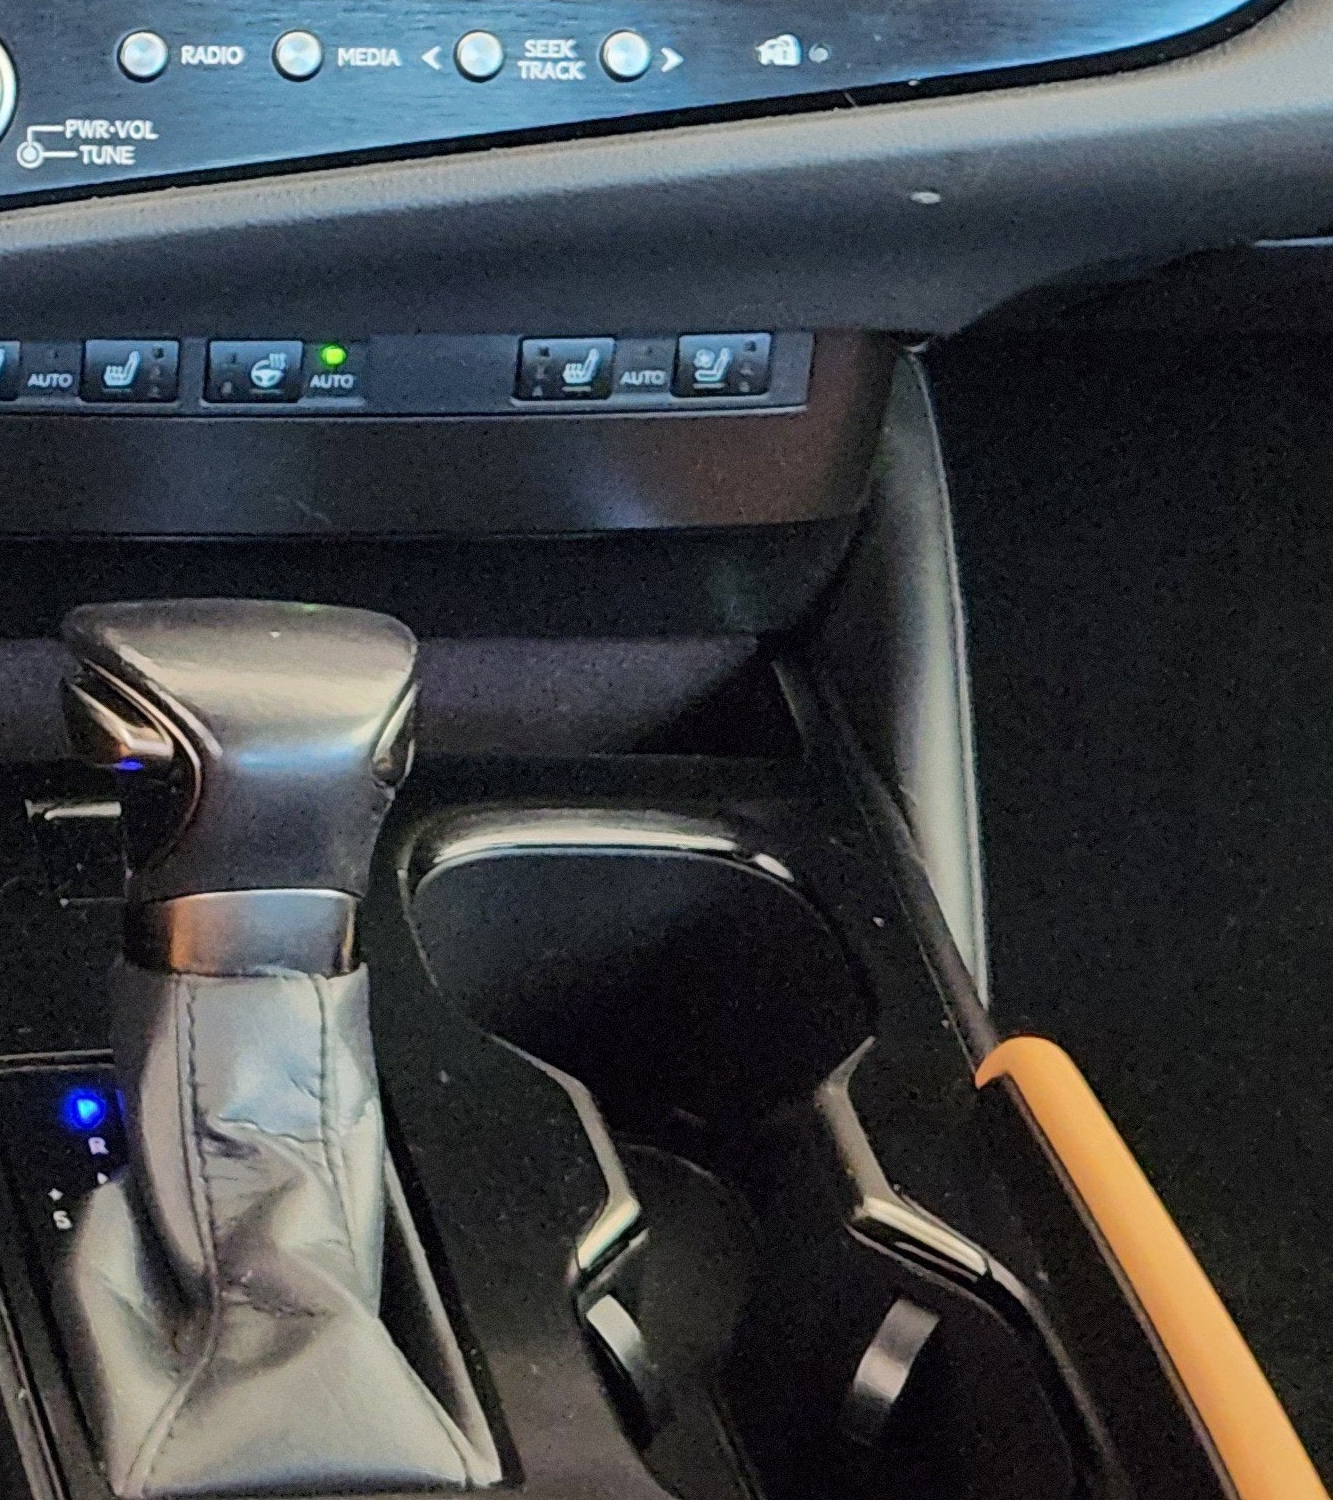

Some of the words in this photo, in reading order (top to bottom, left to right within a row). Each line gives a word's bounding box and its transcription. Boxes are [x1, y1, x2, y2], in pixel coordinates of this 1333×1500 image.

[181, 45, 246, 66] RADIO
[337, 47, 402, 68] MEDIA
[524, 39, 577, 59] SEEK
[517, 60, 586, 81] TRACK
[79, 144, 136, 166] TUNE
[26, 373, 74, 388] AUTO
[309, 374, 355, 389] AUTO
[619, 370, 667, 386] AUTO
[88, 1137, 109, 1156] R
[53, 1210, 73, 1230] S
